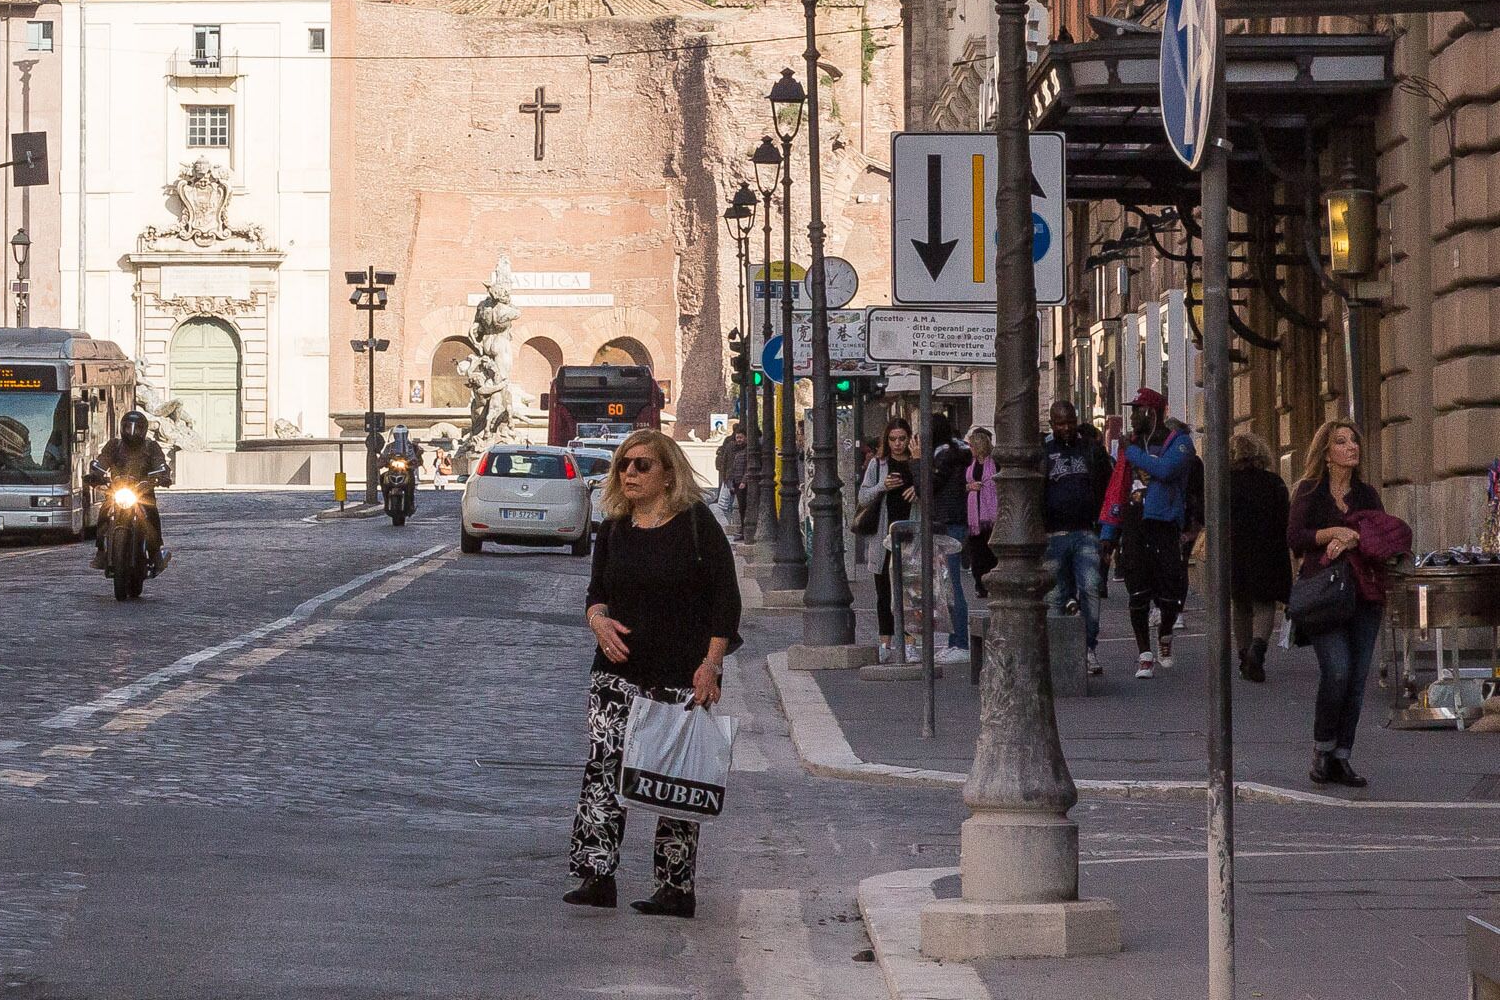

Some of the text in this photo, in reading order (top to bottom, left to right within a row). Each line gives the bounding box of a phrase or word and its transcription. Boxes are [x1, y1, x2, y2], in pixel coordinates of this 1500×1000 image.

[511, 274, 582, 288] ASILICA
[933, 325, 965, 333] operanti
[608, 403, 624, 416] 60
[636, 777, 720, 810] RUBEN
